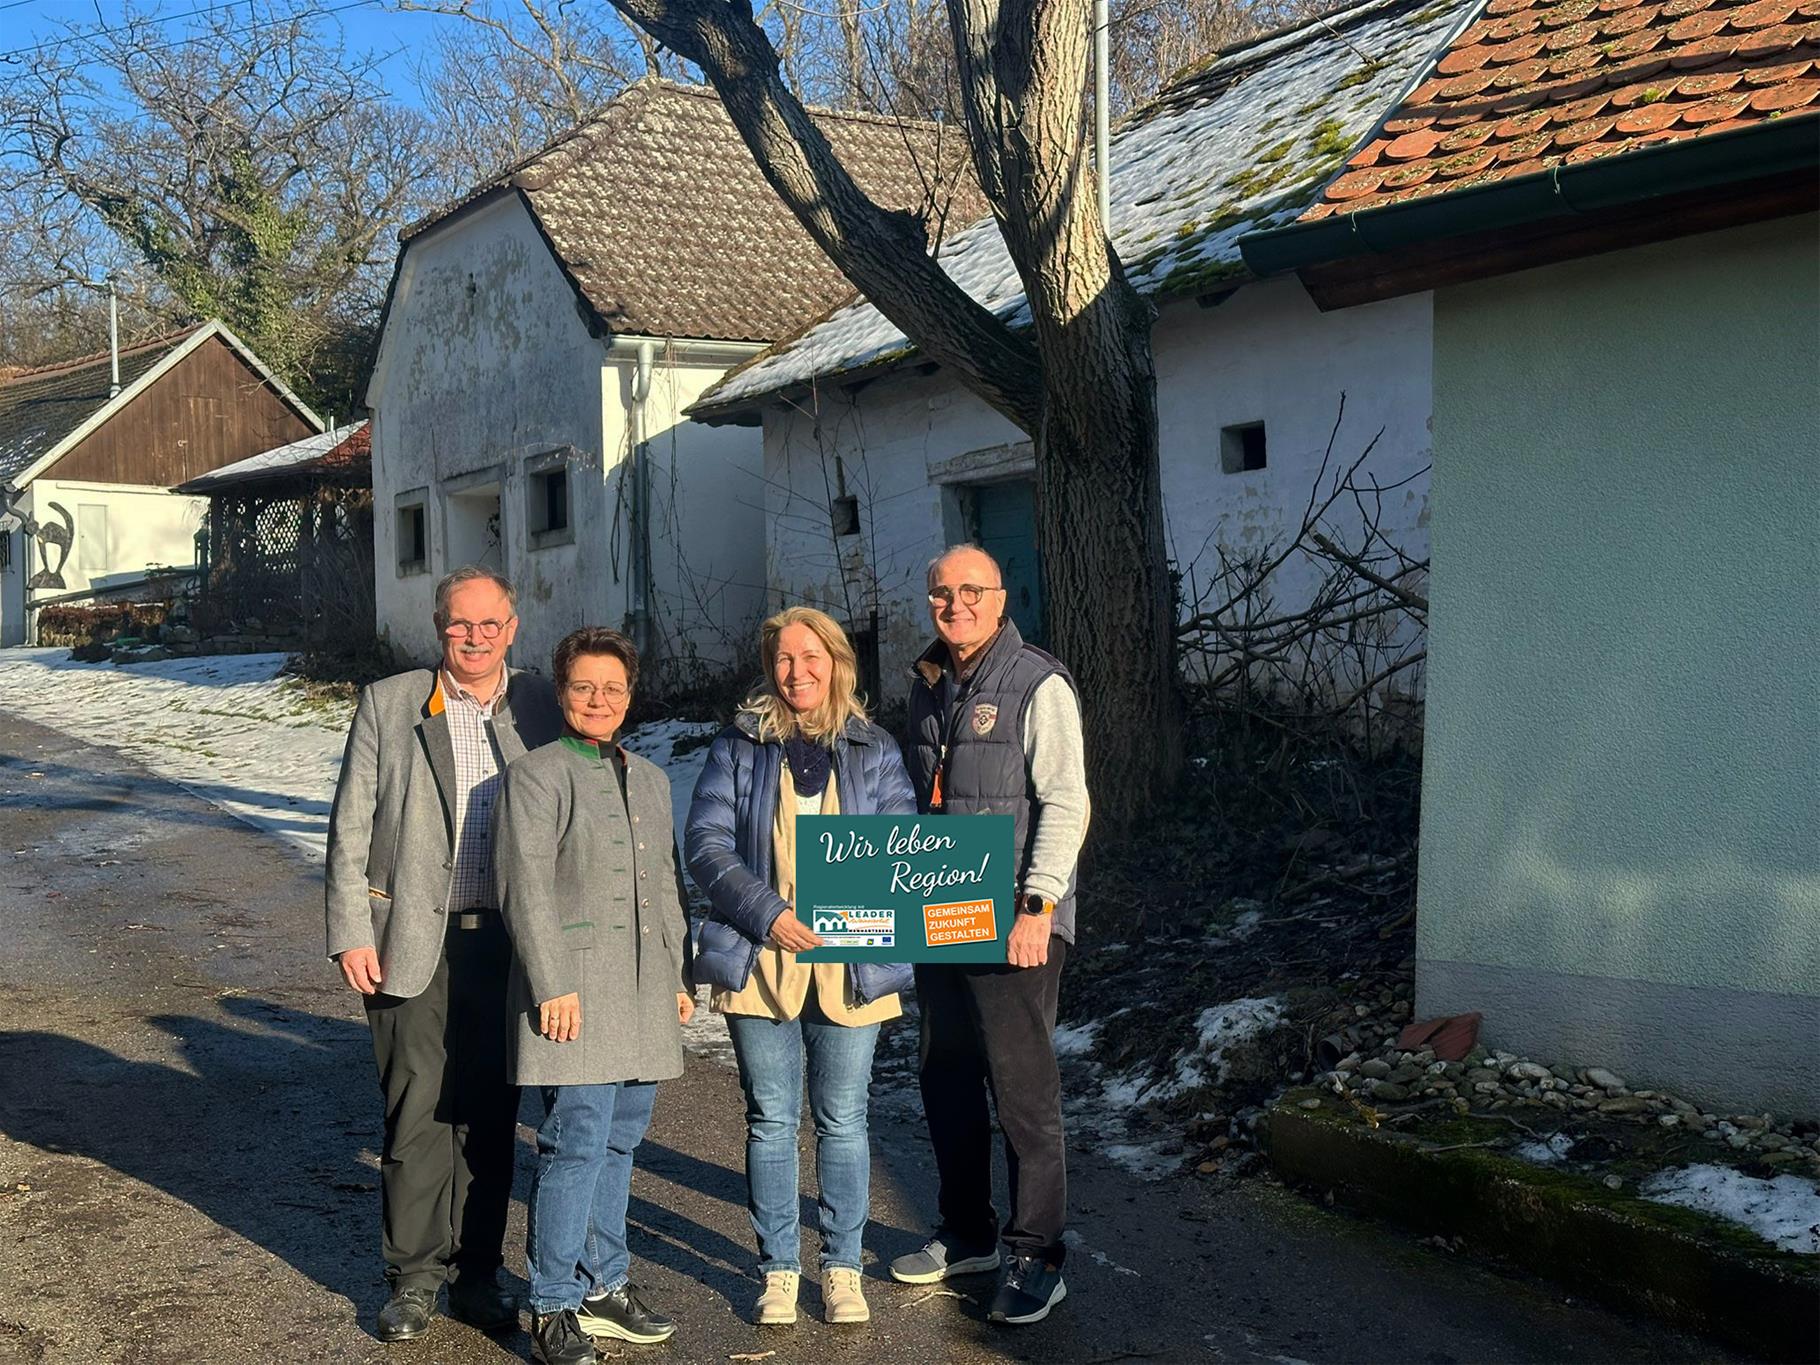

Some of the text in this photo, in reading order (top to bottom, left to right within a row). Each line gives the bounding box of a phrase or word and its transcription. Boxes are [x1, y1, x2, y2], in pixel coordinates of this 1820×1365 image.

[819, 823, 956, 863] Wir leben
[890, 852, 990, 897] Region!
[927, 904, 990, 918] GEMEINSAM
[928, 917, 976, 930] ZUKUNFT
[930, 928, 990, 941] GESTALTEN
